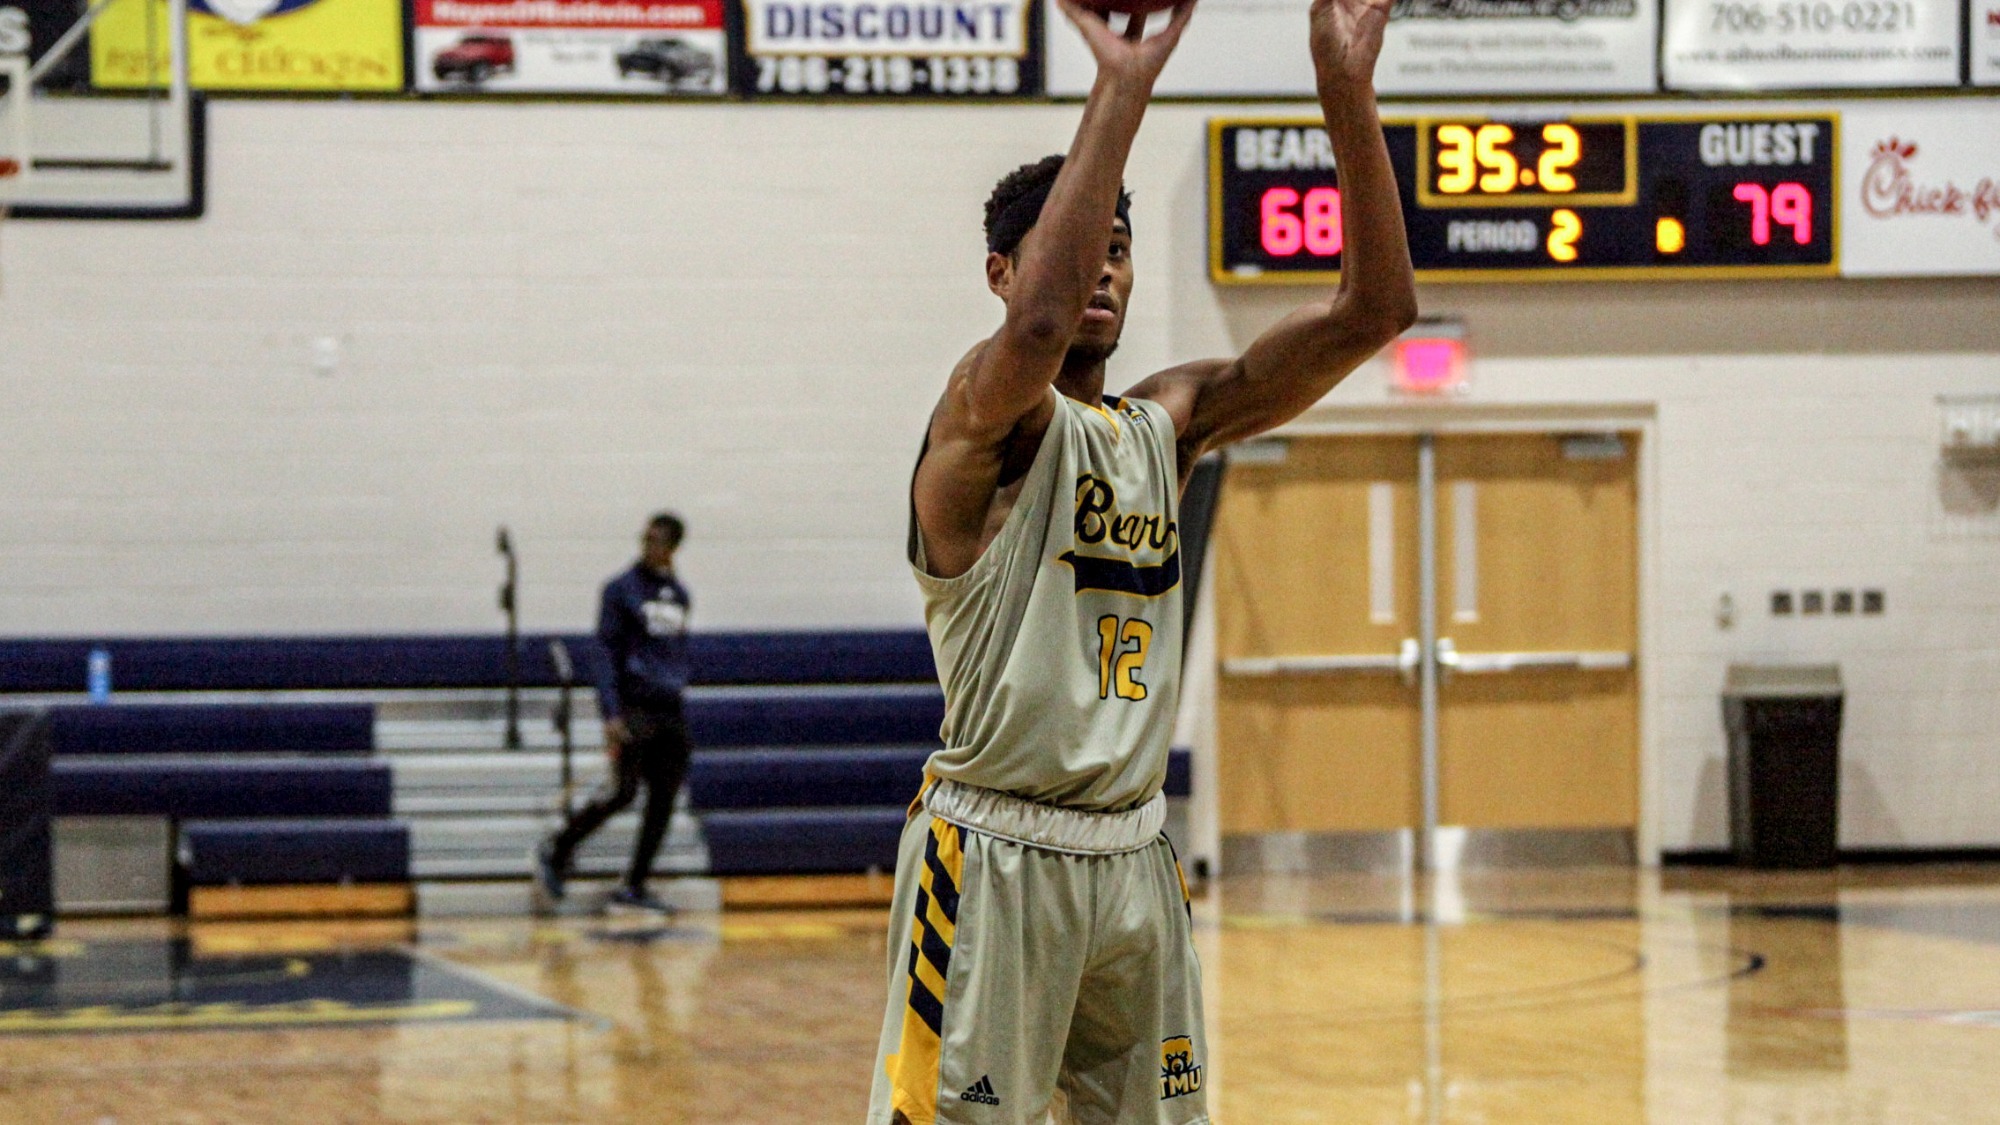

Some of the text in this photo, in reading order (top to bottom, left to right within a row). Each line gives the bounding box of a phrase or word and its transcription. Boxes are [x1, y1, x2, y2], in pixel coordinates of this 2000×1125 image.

[766, 3, 1011, 39] DISCOUNT
[1710, 2, 1916, 32] 706-510-0221
[1236, 128, 1337, 169] BEAR
[1437, 124, 1582, 193] 35.2
[1700, 123, 1820, 166] GUEST
[1261, 187, 1342, 256] 68
[1447, 208, 1583, 262] PERIOD 2
[1733, 182, 1812, 246] 79
[1098, 614, 1153, 701] 12
[960, 1091, 1000, 1106] adidas
